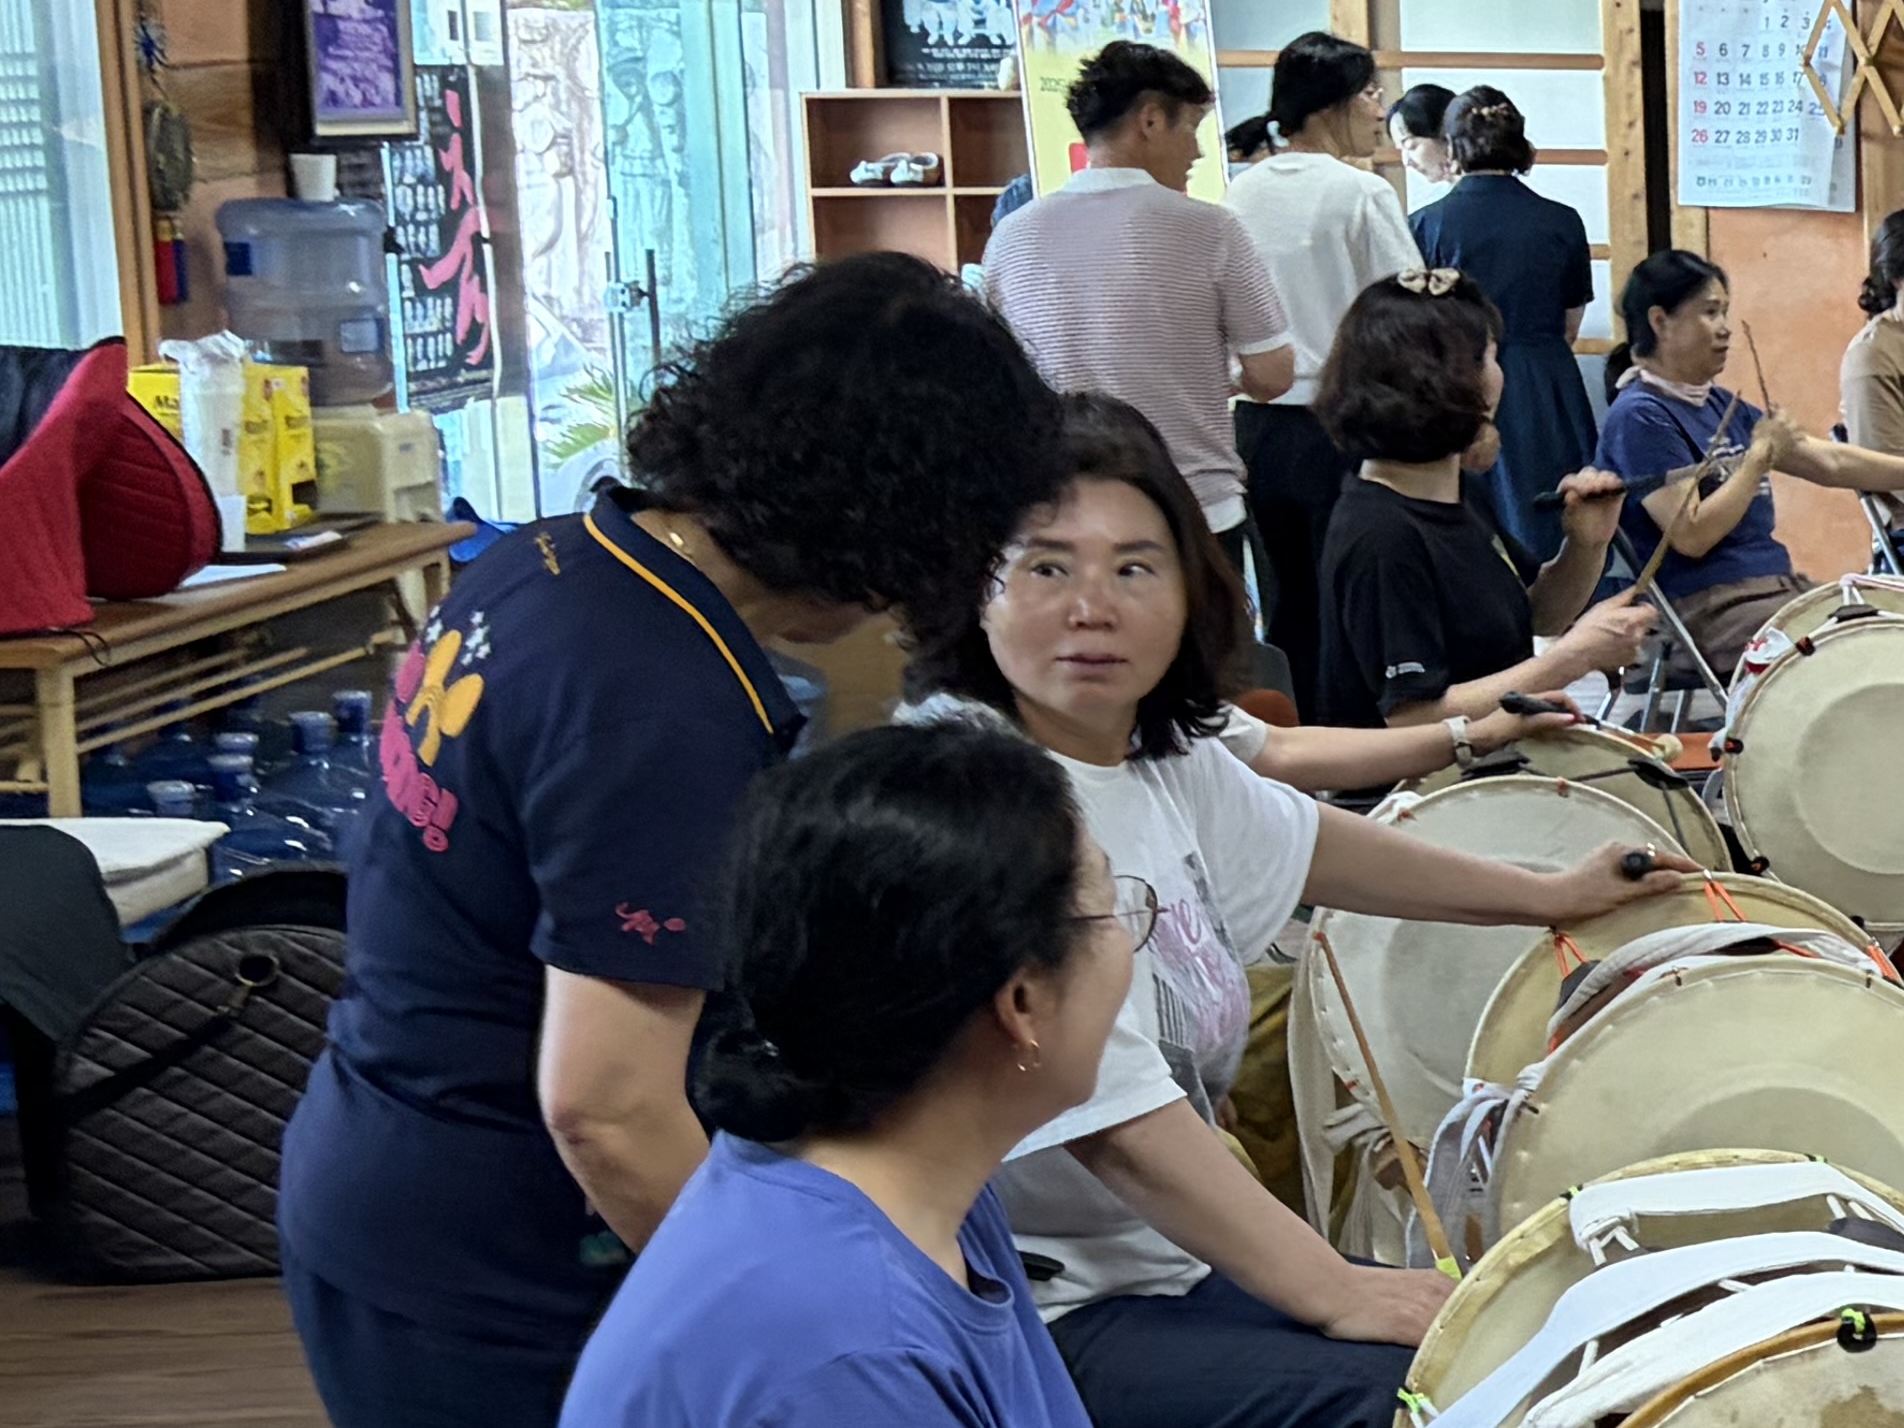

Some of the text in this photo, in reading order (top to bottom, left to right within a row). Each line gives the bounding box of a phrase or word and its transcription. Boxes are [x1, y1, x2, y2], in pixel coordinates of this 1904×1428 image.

[1780, 15, 1789, 28] 2
[1801, 16, 1810, 30] 3
[1696, 42, 1705, 56] 5
[1719, 43, 1728, 57] 6
[1741, 44, 1750, 58] 7
[1778, 43, 1786, 57] 9
[1694, 71, 1708, 85] 12
[1717, 71, 1730, 86] 13
[1739, 72, 1752, 86] 14
[1693, 100, 1707, 114] 19
[1714, 100, 1731, 115] 20
[1738, 101, 1750, 115] 21
[1756, 101, 1769, 115] 22
[1772, 100, 1784, 114] 23
[1788, 99, 1803, 113] 24
[1691, 128, 1799, 145] 26 27 28 29 30 31
